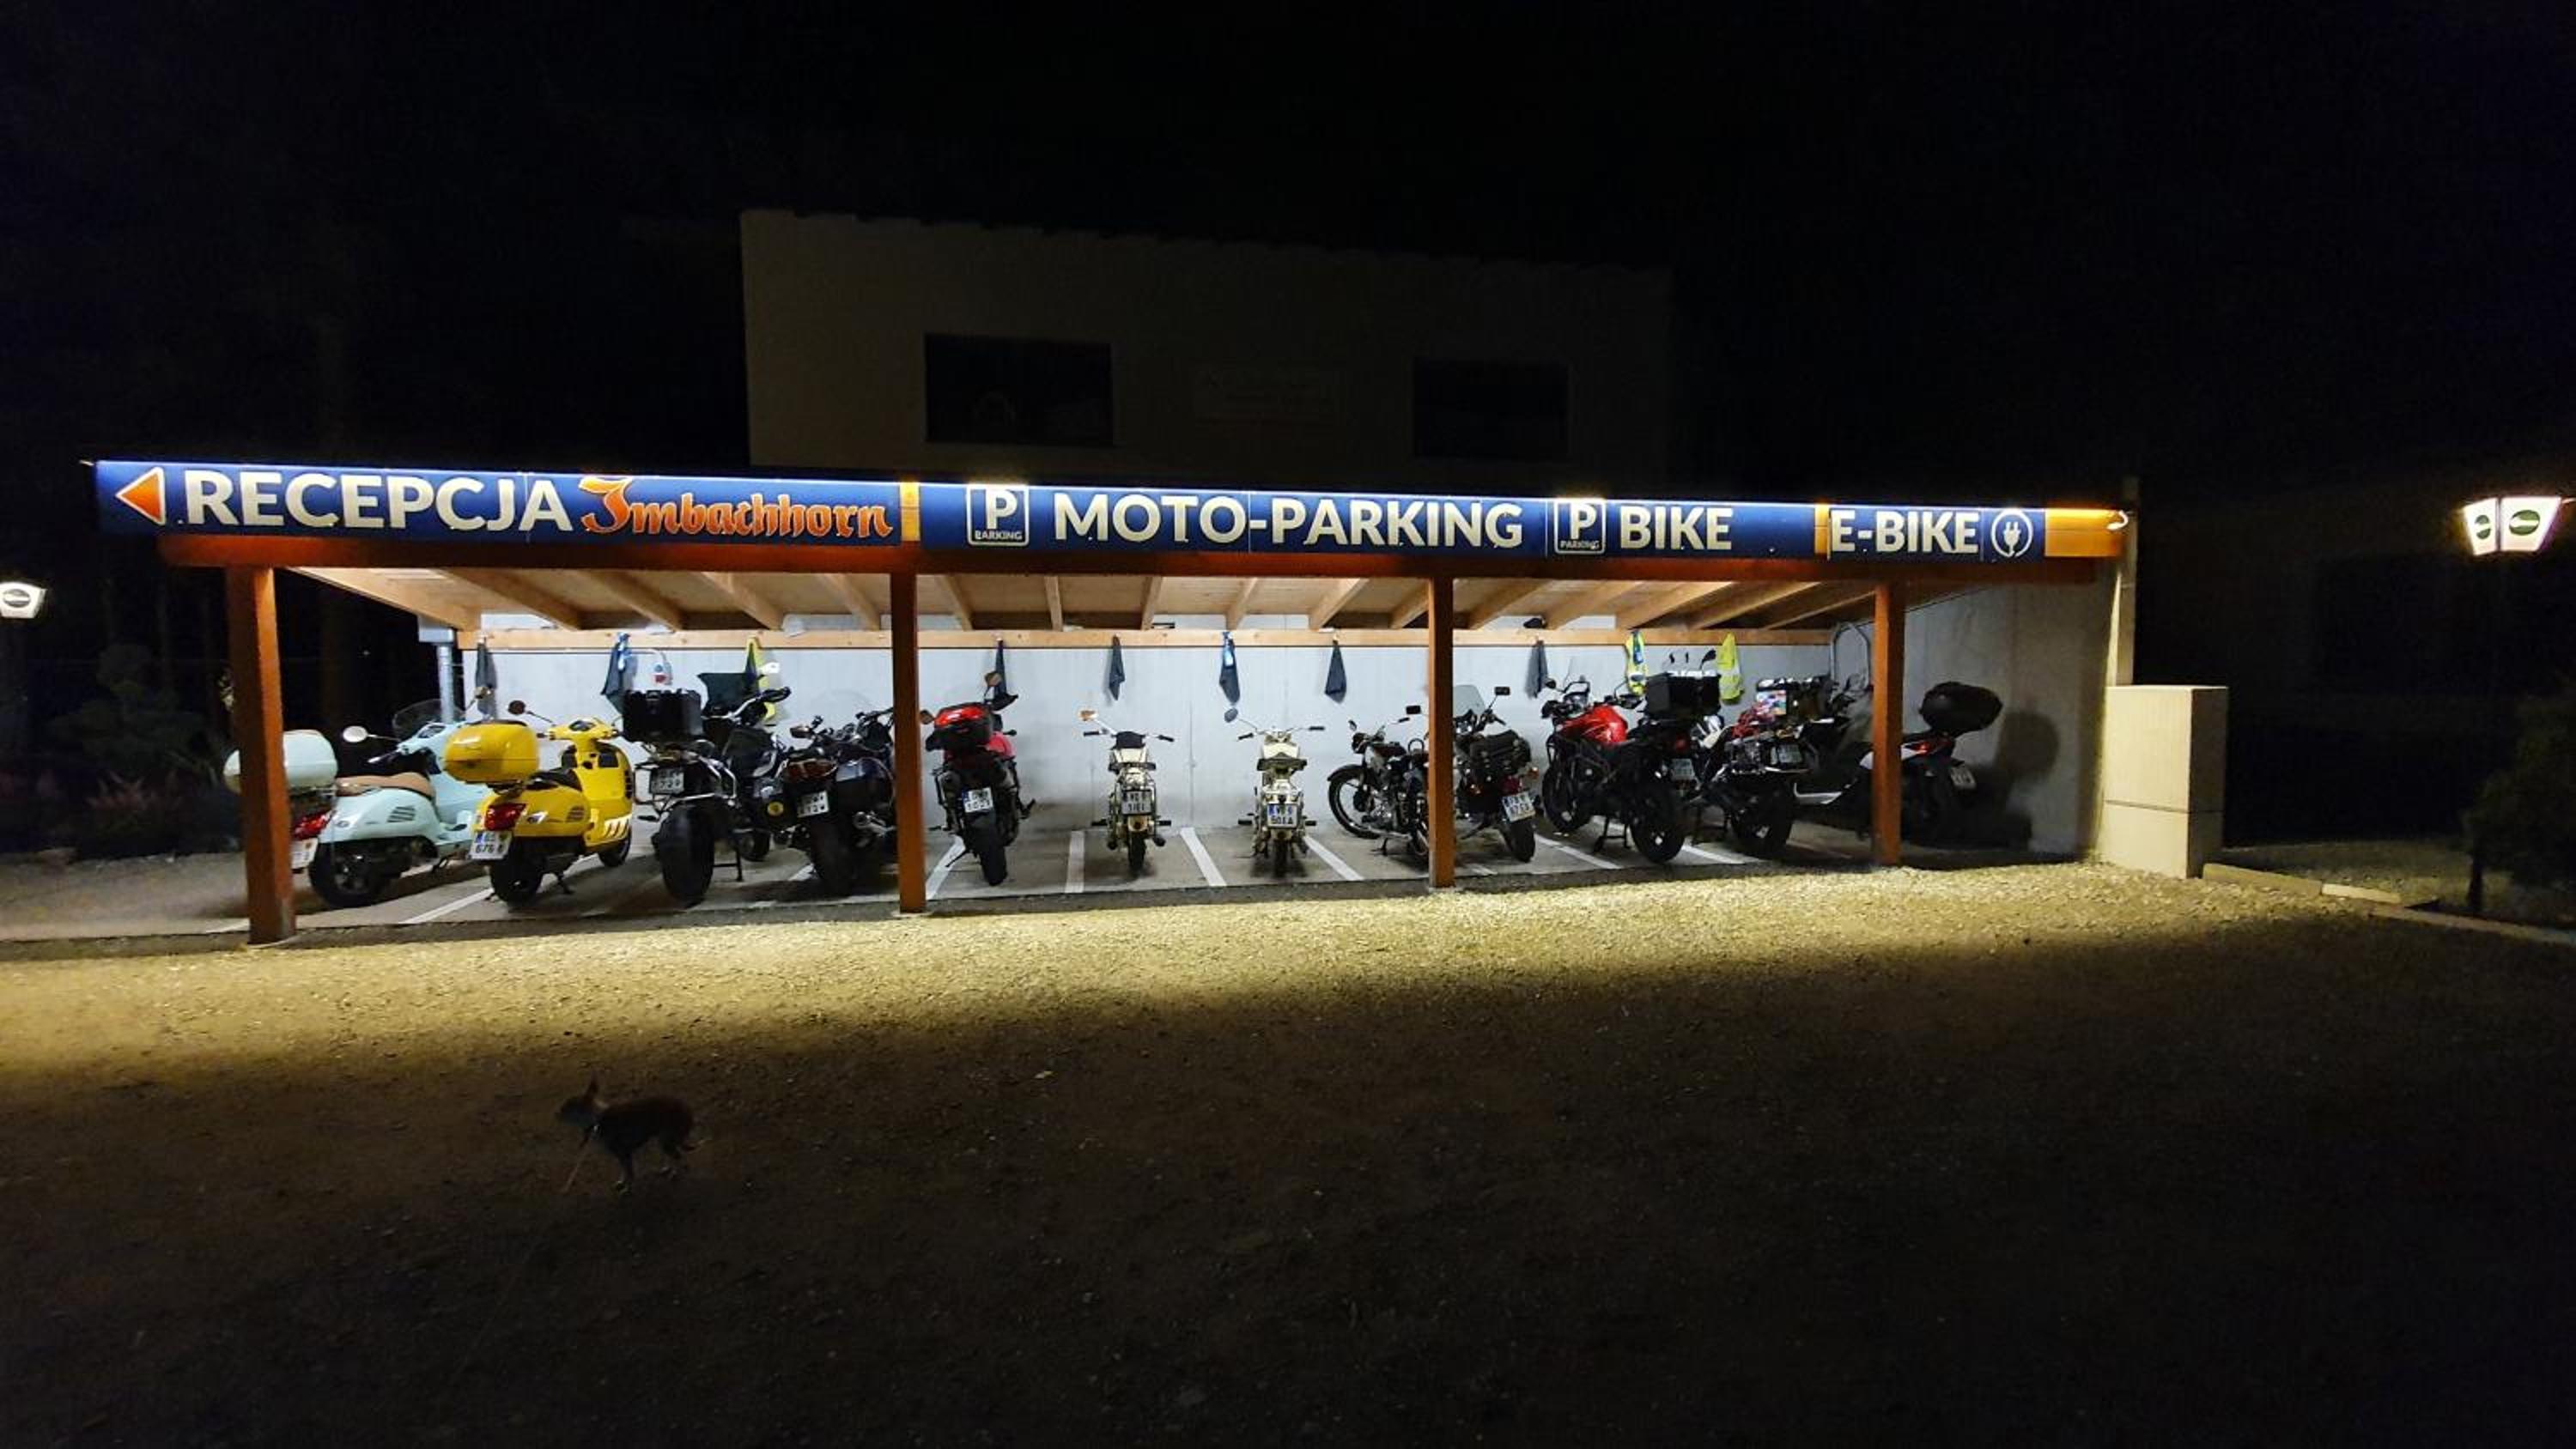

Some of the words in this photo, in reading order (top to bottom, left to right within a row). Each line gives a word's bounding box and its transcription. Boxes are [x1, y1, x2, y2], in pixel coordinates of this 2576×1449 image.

[183, 469, 574, 532] RECEPCJA
[986, 487, 1018, 529] P
[1053, 493, 1523, 548] MOTO-PARKING
[1571, 500, 1597, 539] P
[1619, 506, 1733, 551] BIKE
[1830, 510, 1979, 555] E-BIKE
